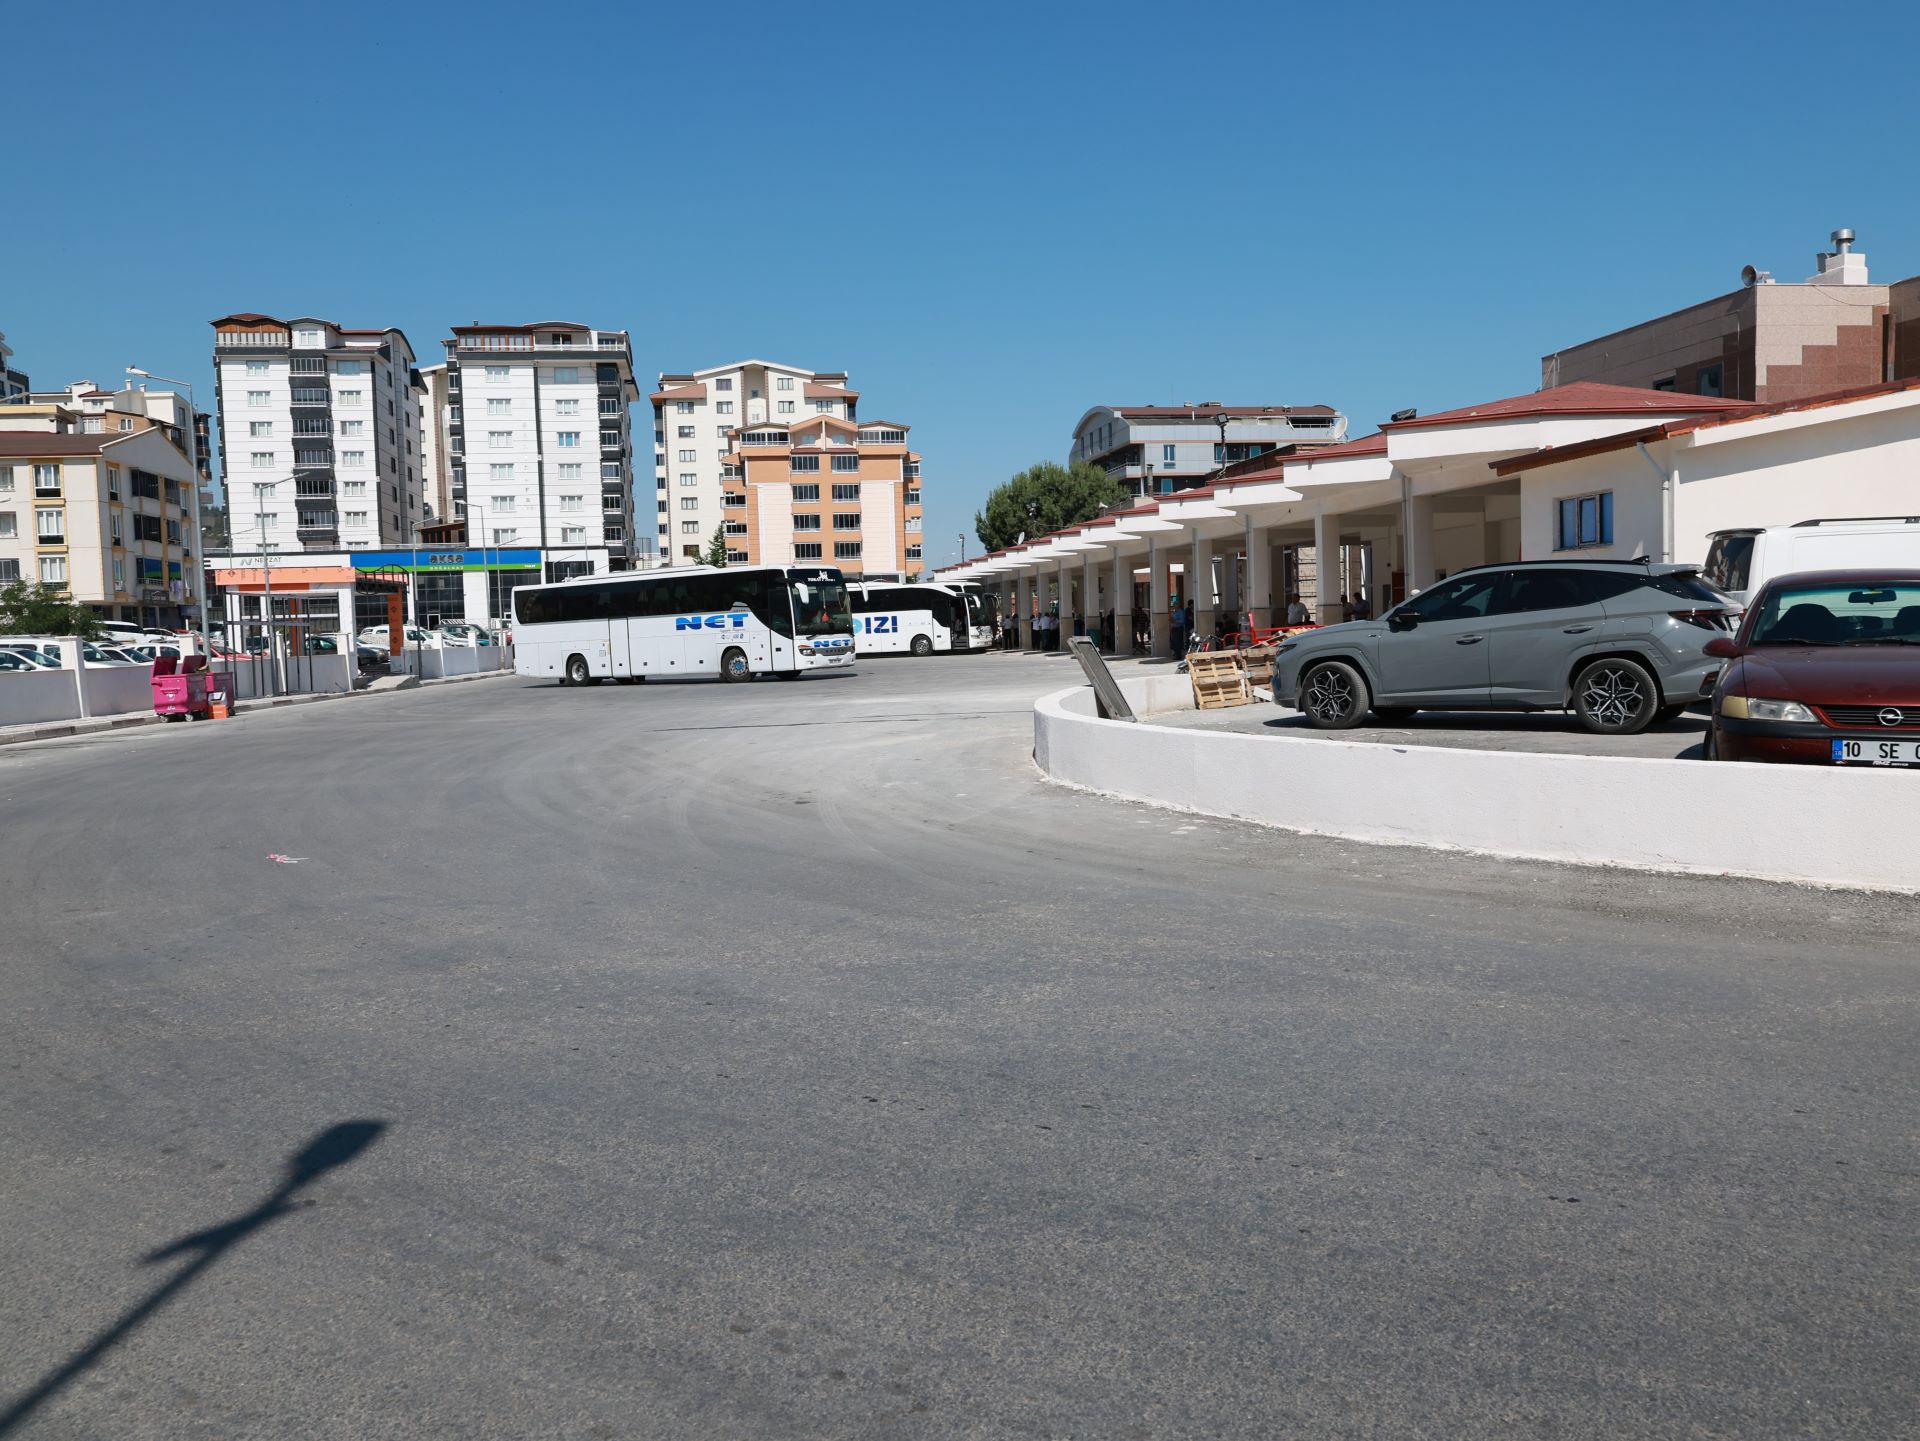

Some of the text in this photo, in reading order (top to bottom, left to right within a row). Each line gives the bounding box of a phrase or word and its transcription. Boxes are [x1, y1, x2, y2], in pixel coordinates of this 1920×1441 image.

[430, 554, 464, 564] aksa
[676, 613, 749, 631] NET
[814, 639, 851, 648] NET
[1844, 742, 1861, 757] 10
[1879, 743, 1899, 759] SE
